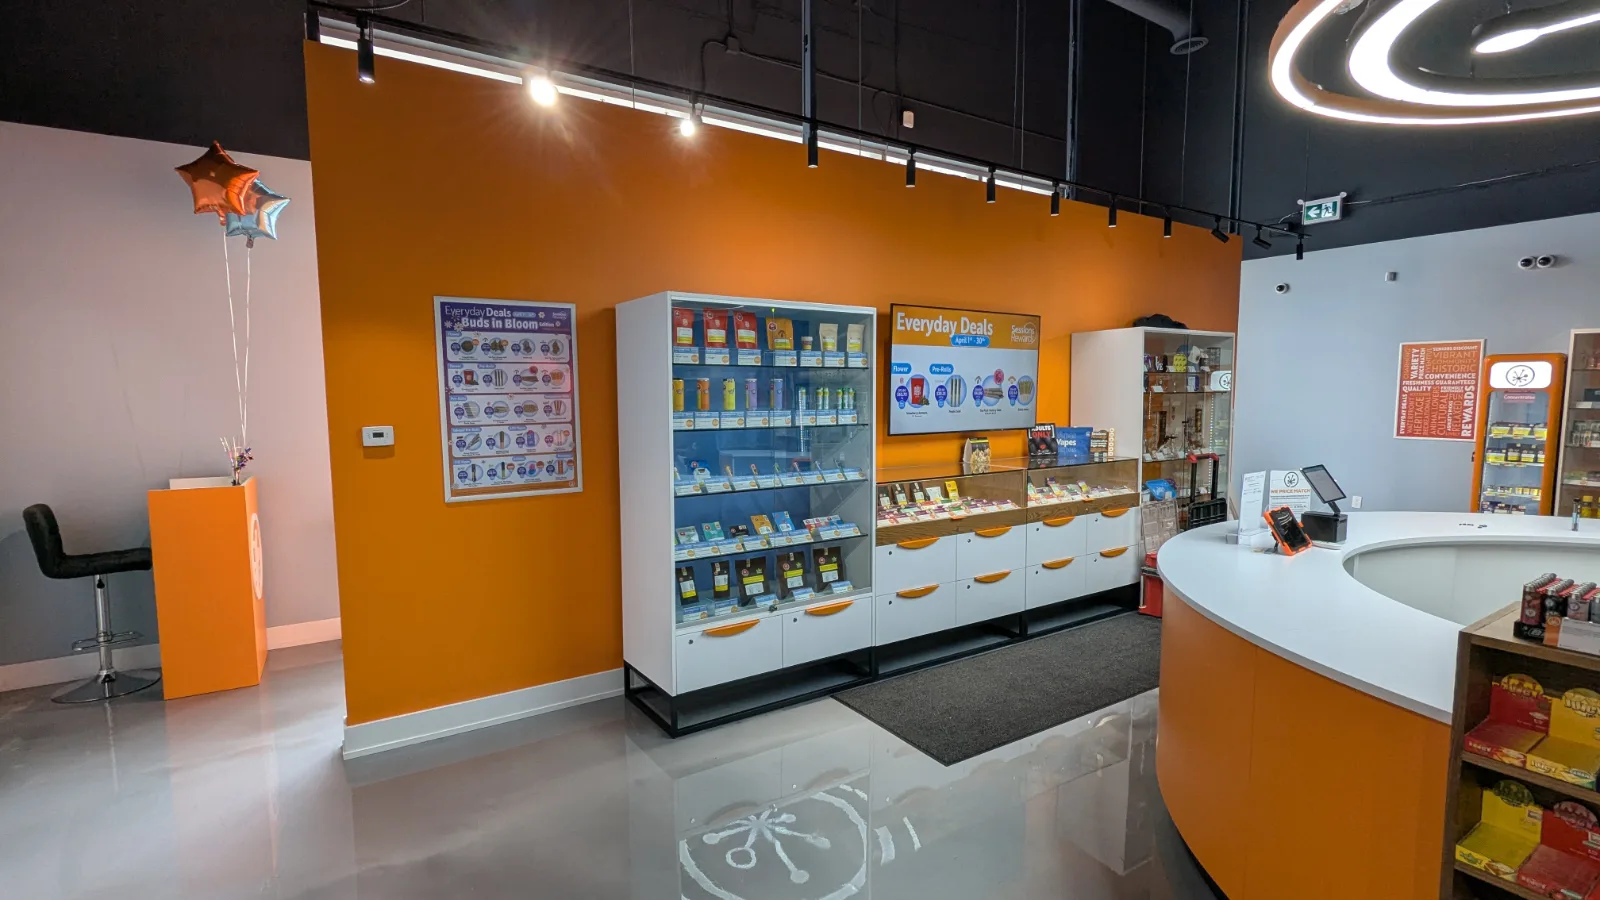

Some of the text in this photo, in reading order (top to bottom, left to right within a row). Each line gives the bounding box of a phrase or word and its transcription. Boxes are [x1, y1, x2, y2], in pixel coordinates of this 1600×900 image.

[444, 305, 486, 318] Everyday
[486, 307, 512, 318] Deals
[462, 317, 490, 328] Buds
[491, 318, 503, 328] in
[505, 319, 538, 330] Bloom
[896, 312, 993, 337] Everyday Deals
[1011, 324, 1035, 335] Sessions
[955, 336, 967, 345] April
[1410, 348, 1420, 379] VARIETY
[1433, 350, 1478, 359] VIBRANT
[1432, 364, 1476, 373] HISTORIC
[1413, 396, 1424, 435] HERITAGE
[1423, 397, 1431, 435] RECREATIONAL
[1430, 386, 1440, 435] ANIMAL LOVERS
[1437, 393, 1448, 436] CULTURAL
[1452, 401, 1463, 432] RELAXED
[1461, 386, 1475, 437] REWARDS
[1056, 438, 1077, 447] Vapes
